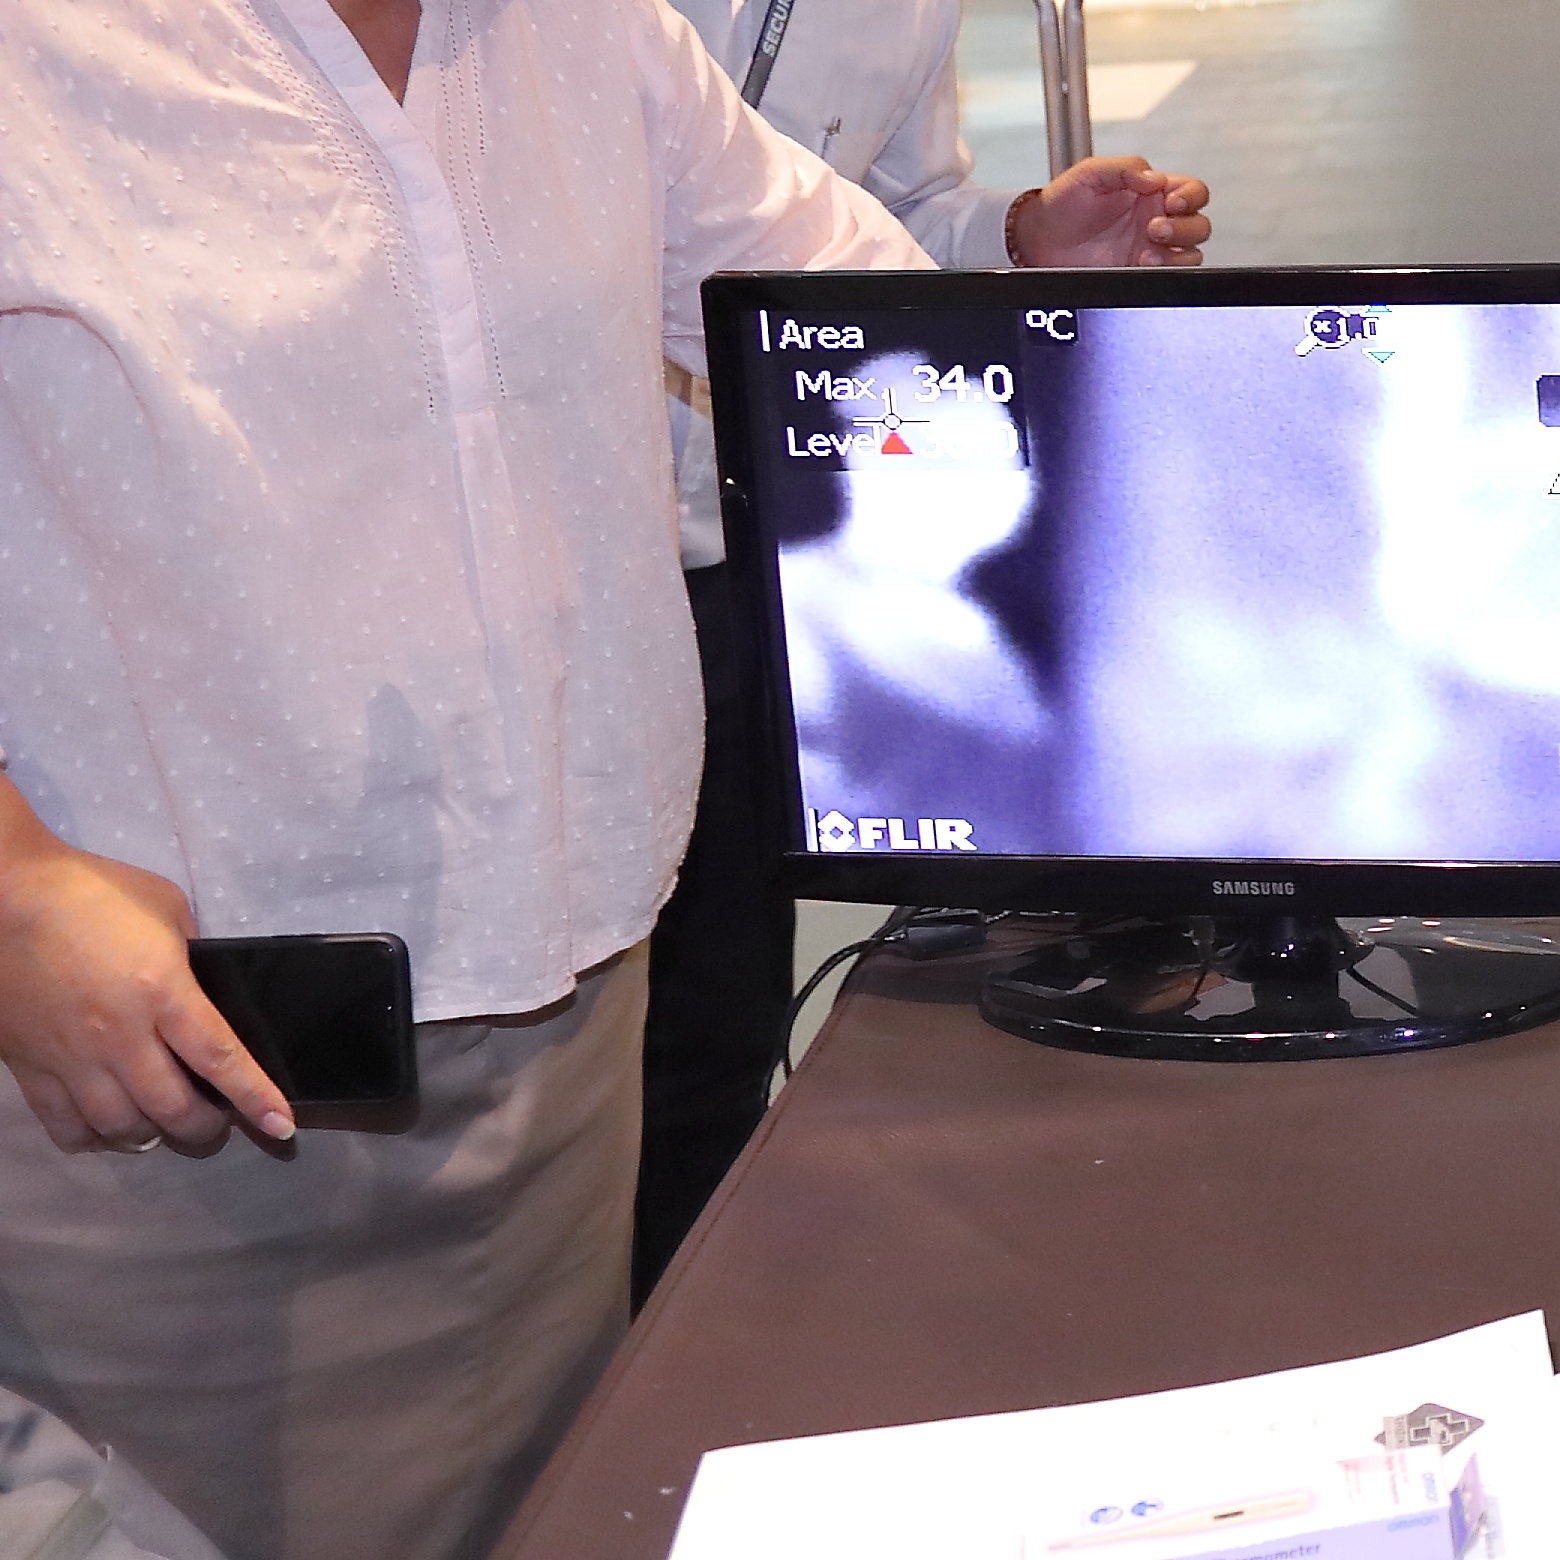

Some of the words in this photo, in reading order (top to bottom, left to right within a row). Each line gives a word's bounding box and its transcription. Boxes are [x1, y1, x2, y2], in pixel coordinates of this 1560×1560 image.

[779, 319, 865, 349] Area
[912, 364, 1014, 403] 34.0
[857, 817, 978, 851] FLIR
[1212, 880, 1296, 896] SAMSUNG
